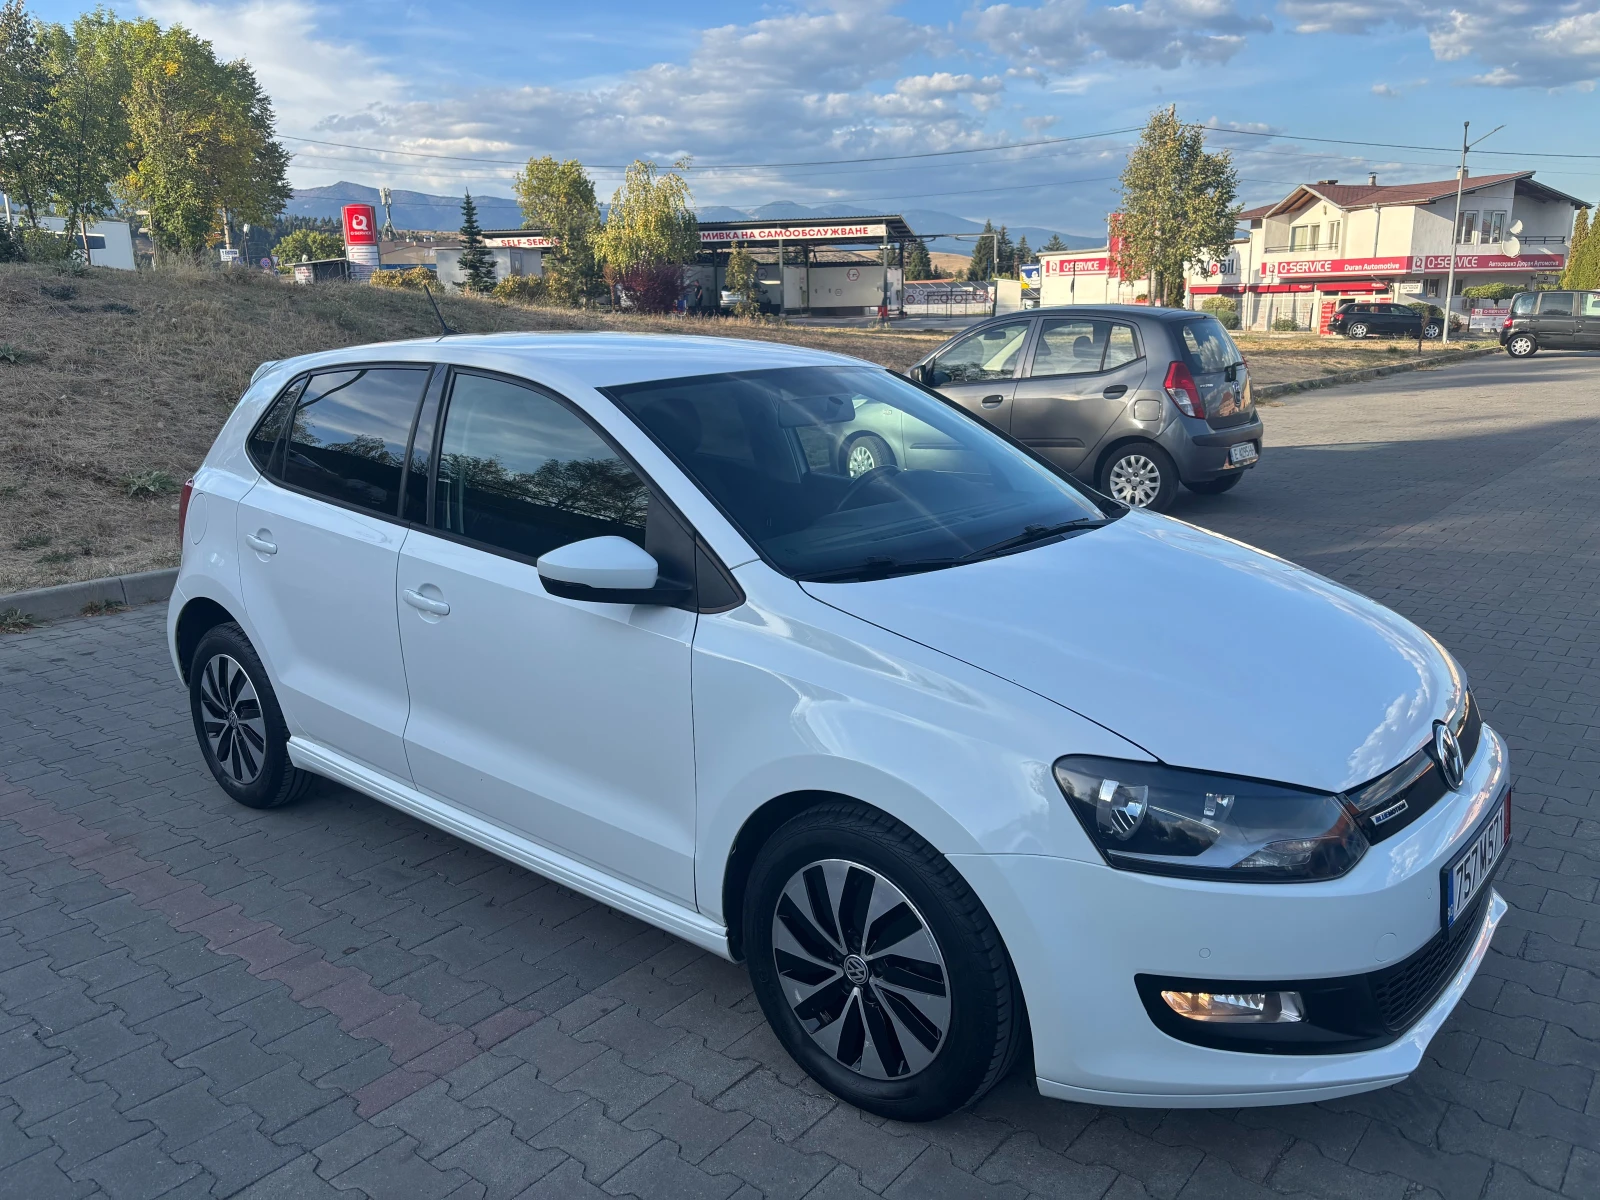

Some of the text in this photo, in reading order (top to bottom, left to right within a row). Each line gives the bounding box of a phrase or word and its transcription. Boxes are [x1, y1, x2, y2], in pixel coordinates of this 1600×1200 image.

[696, 226, 869, 241] МИВКА НА САМООБСЛУЖВАНЕ
[1280, 261, 1400, 273] Q-SERVICE Duran Automotive
[1427, 256, 1479, 268] Q-SEVICE
